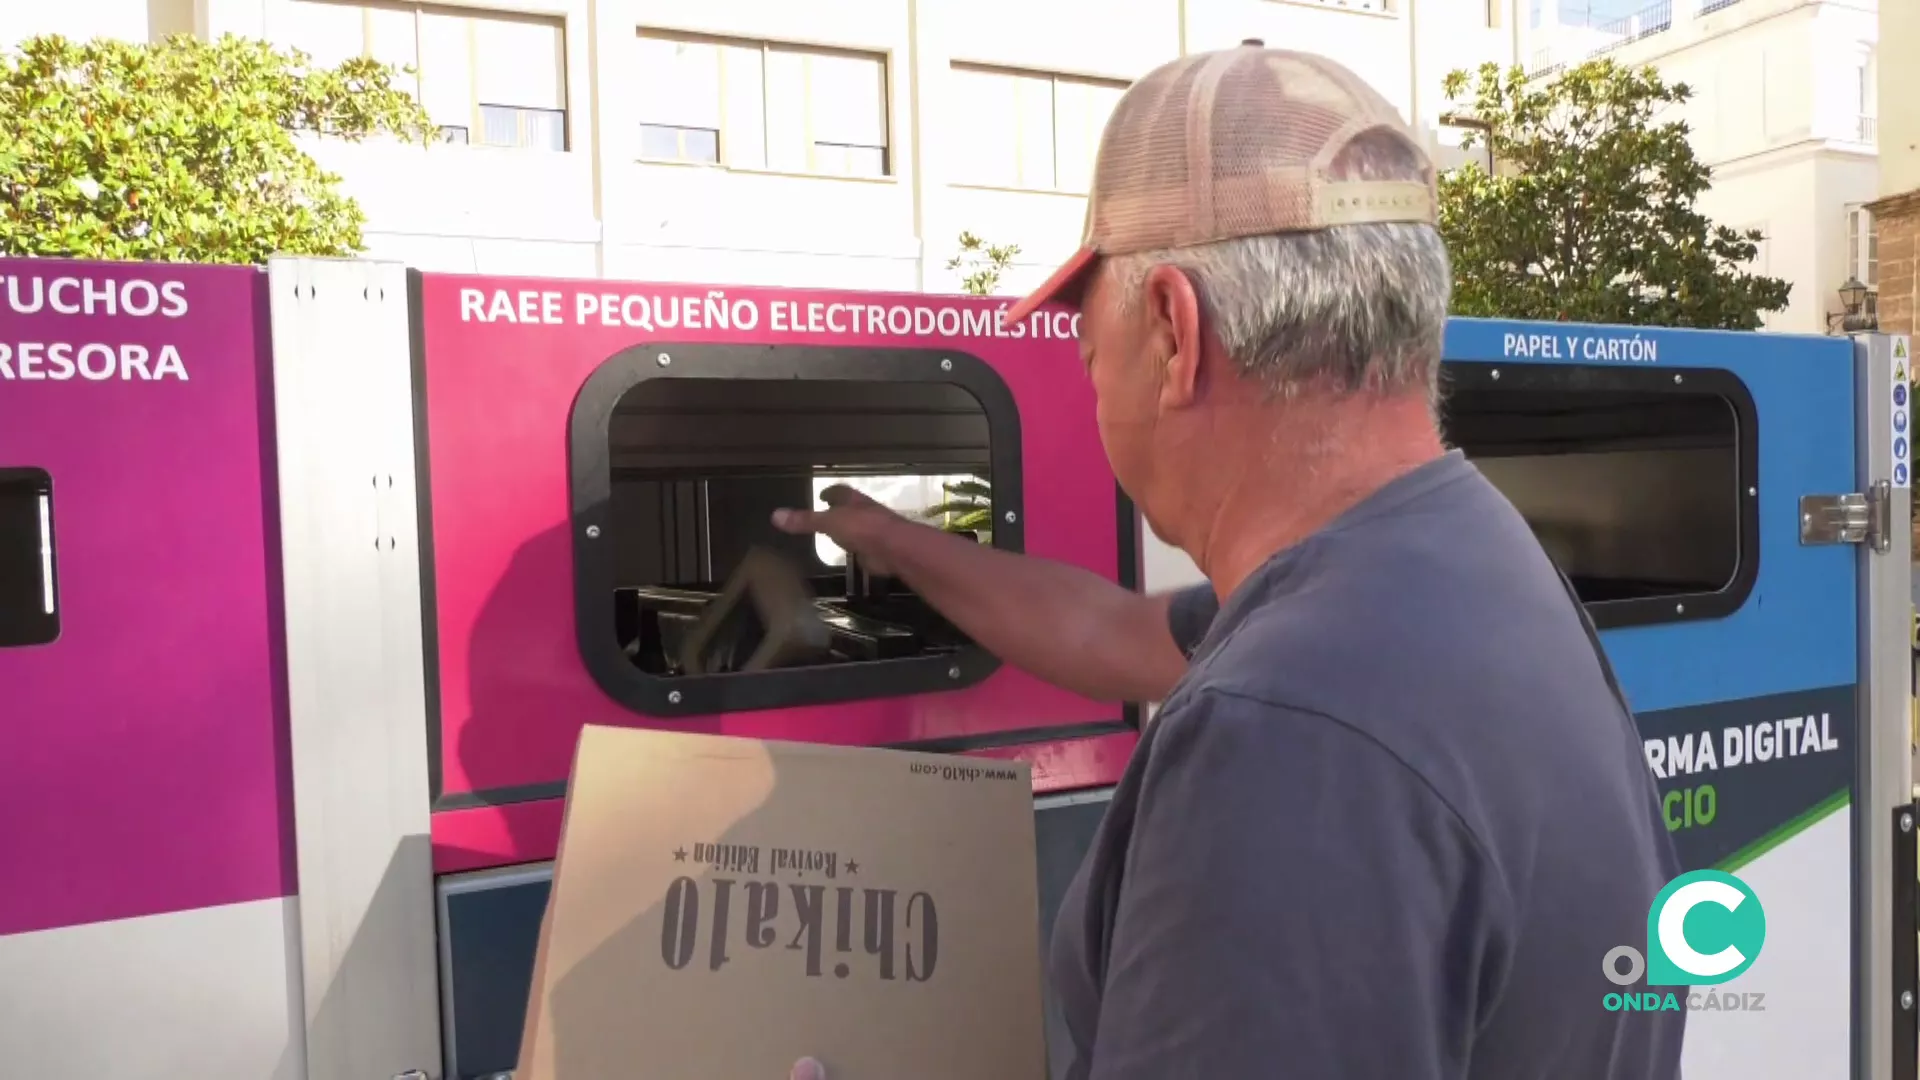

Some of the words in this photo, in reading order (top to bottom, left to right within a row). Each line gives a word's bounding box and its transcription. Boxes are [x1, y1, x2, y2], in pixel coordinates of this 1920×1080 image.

[0, 275, 188, 317] UCHOS
[460, 288, 563, 324] RAEE
[576, 290, 759, 332] PEQUEÑO
[1504, 333, 1562, 358] PAPEL
[1566, 336, 1579, 359] Y
[1583, 333, 1657, 362] CARTÓN
[1644, 730, 1718, 778] RMA
[1723, 712, 1838, 768] DIGITAL
[910, 762, 1017, 782] www.chk10.com
[1663, 784, 1717, 832] CIO
[694, 842, 760, 873] Edition
[771, 847, 837, 878] Revival
[660, 875, 939, 982] Chika10
